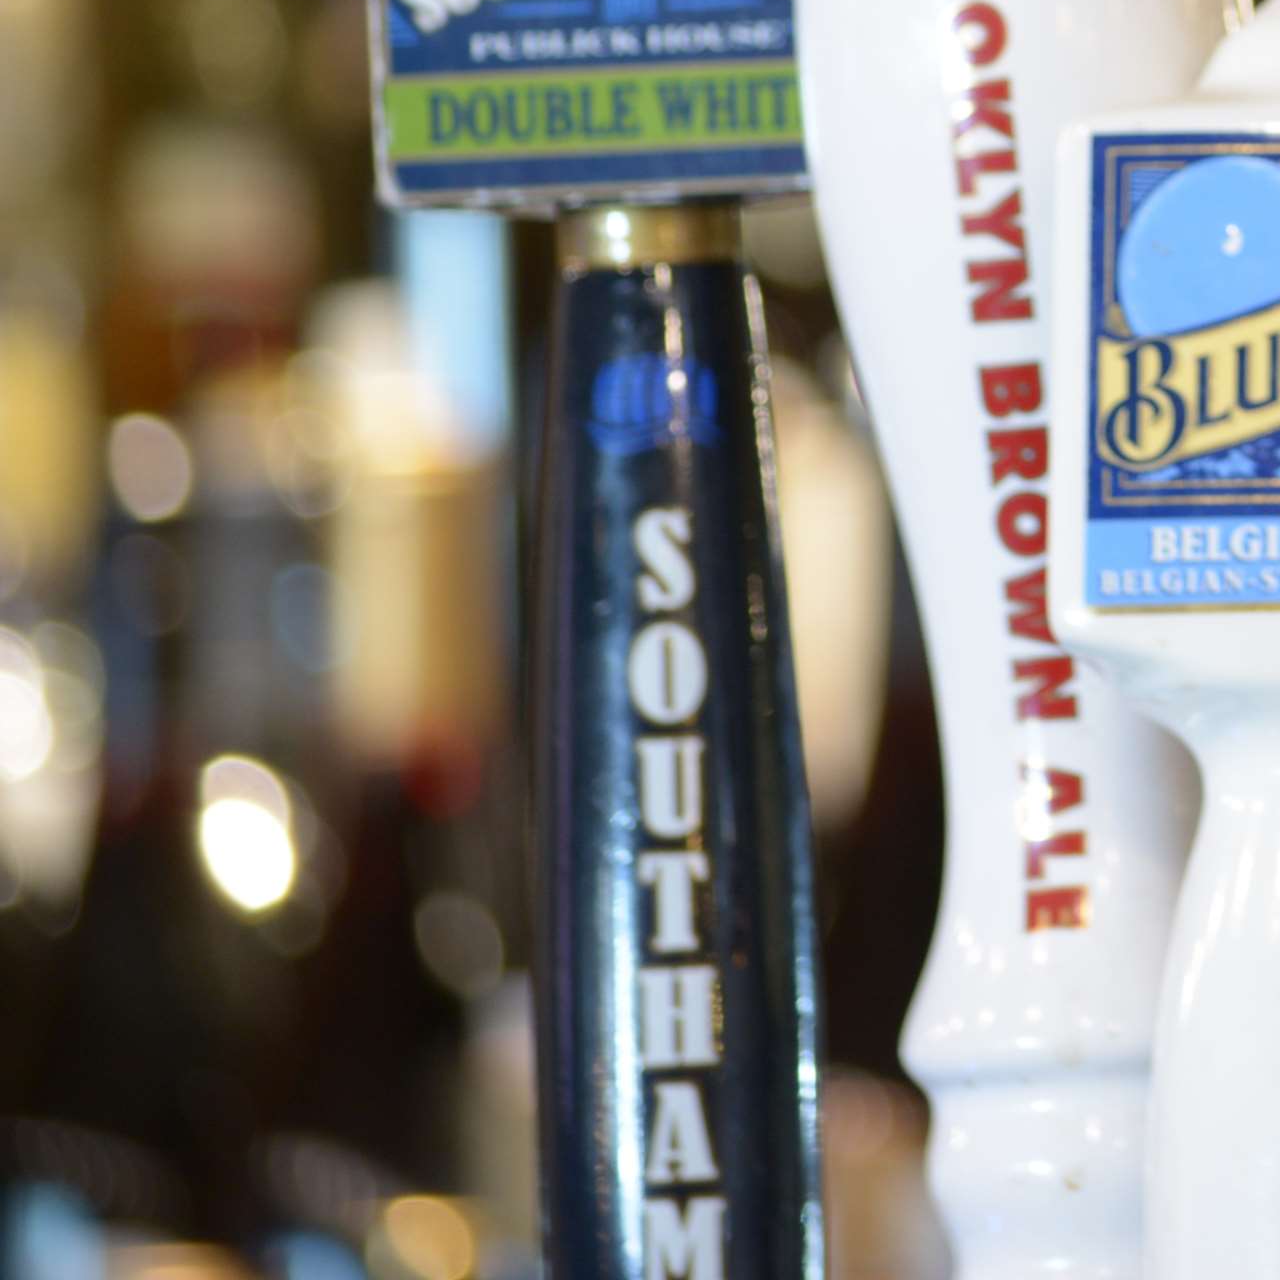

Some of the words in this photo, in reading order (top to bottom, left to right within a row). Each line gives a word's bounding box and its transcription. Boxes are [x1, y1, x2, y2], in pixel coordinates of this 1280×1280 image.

[426, 80, 643, 147] DOUBLE
[978, 361, 1079, 721] BROWN
[1019, 764, 1091, 934] ALE
